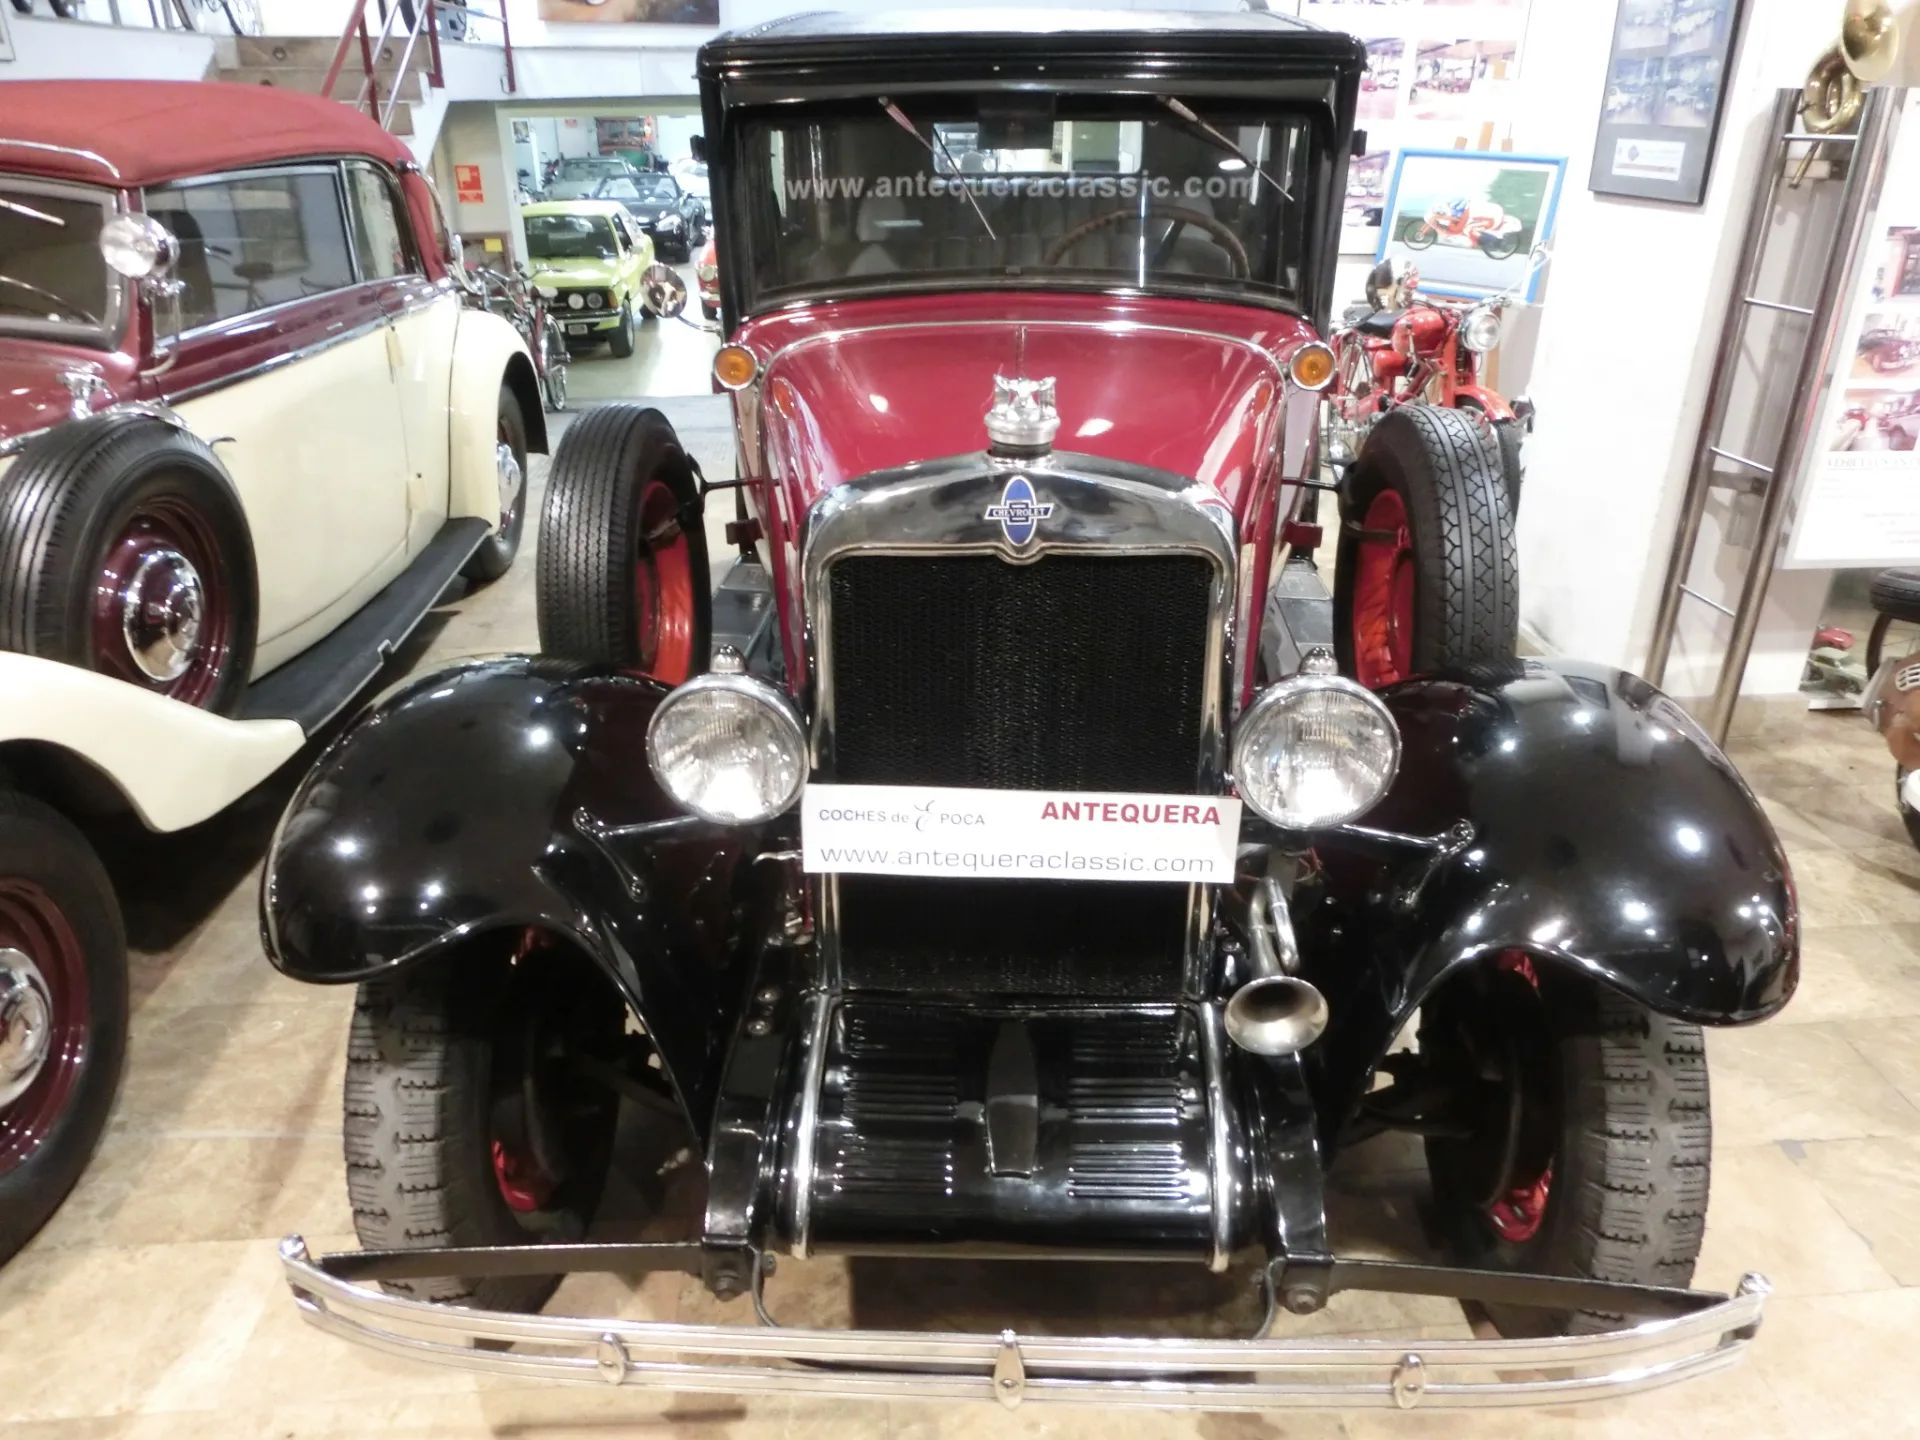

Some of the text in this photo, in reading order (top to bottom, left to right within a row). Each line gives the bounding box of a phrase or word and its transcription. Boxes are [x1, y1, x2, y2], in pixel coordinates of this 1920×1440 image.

[787, 171, 1256, 202] www.antequeraclassic.com
[992, 508, 1045, 517] CHEVROLET
[819, 809, 887, 823] COCHES
[891, 812, 909, 823] de
[1041, 801, 1221, 825] ANTEQUERA
[821, 848, 1214, 872] www.antequeraclassic.com
